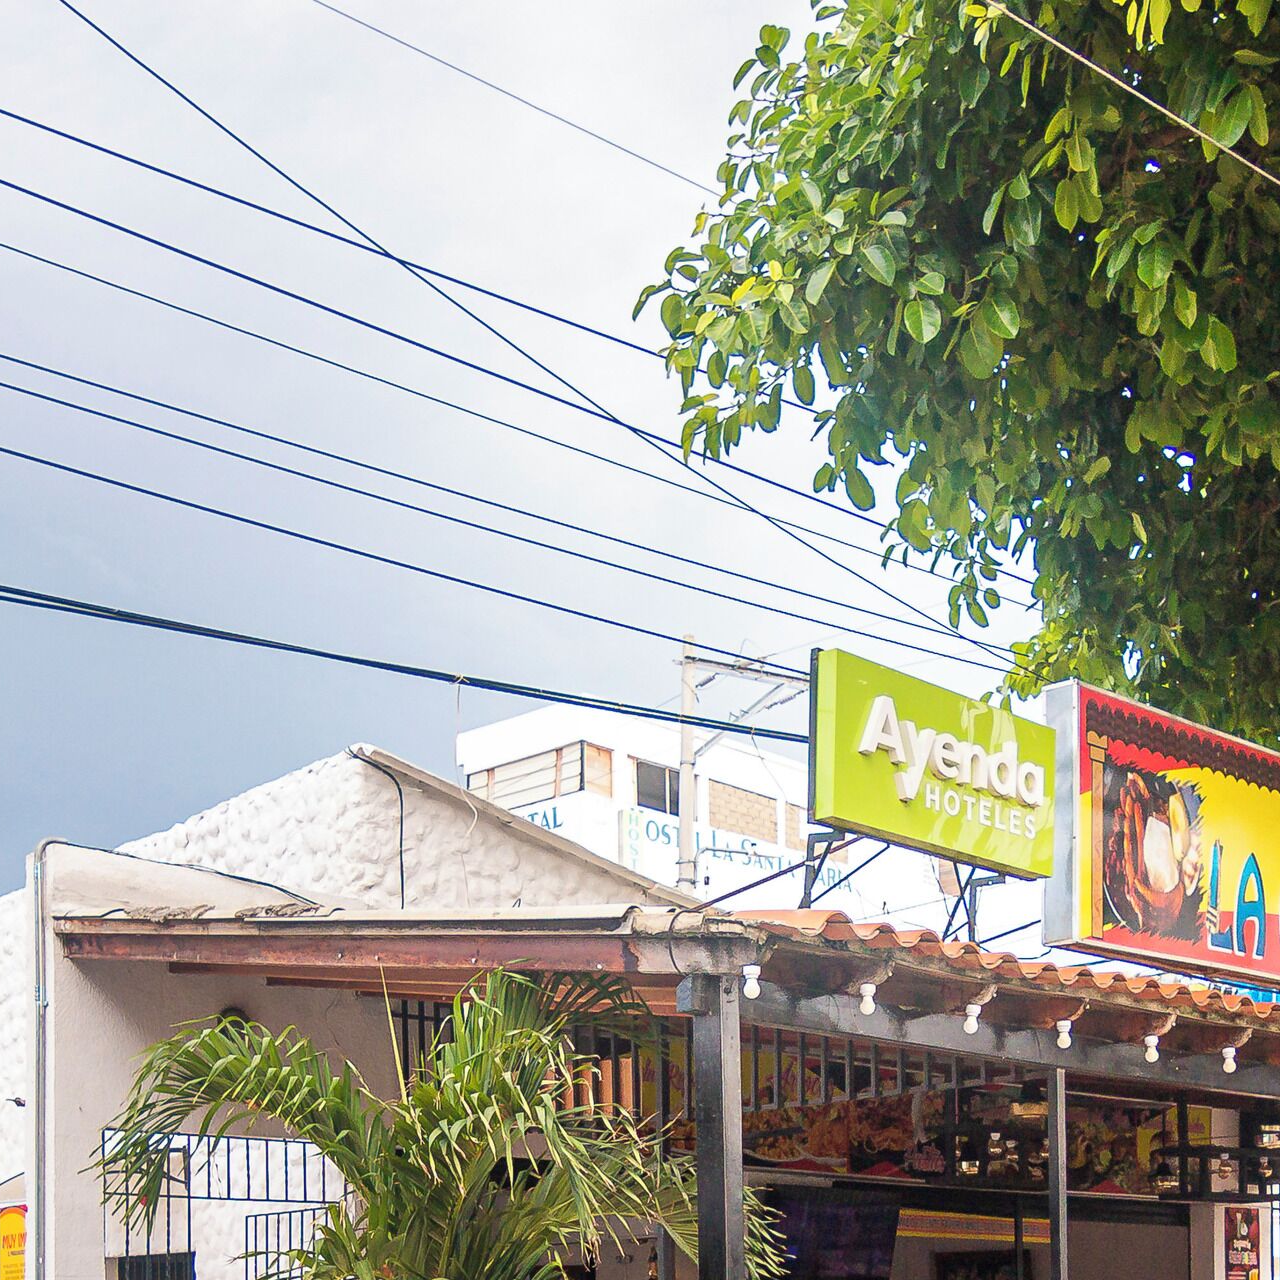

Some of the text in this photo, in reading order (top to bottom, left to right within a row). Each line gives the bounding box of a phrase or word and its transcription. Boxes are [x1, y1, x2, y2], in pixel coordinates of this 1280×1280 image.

[858, 695, 1045, 808] Ayenda
[925, 783, 1036, 839] HOTELES
[1207, 840, 1267, 960] LA
